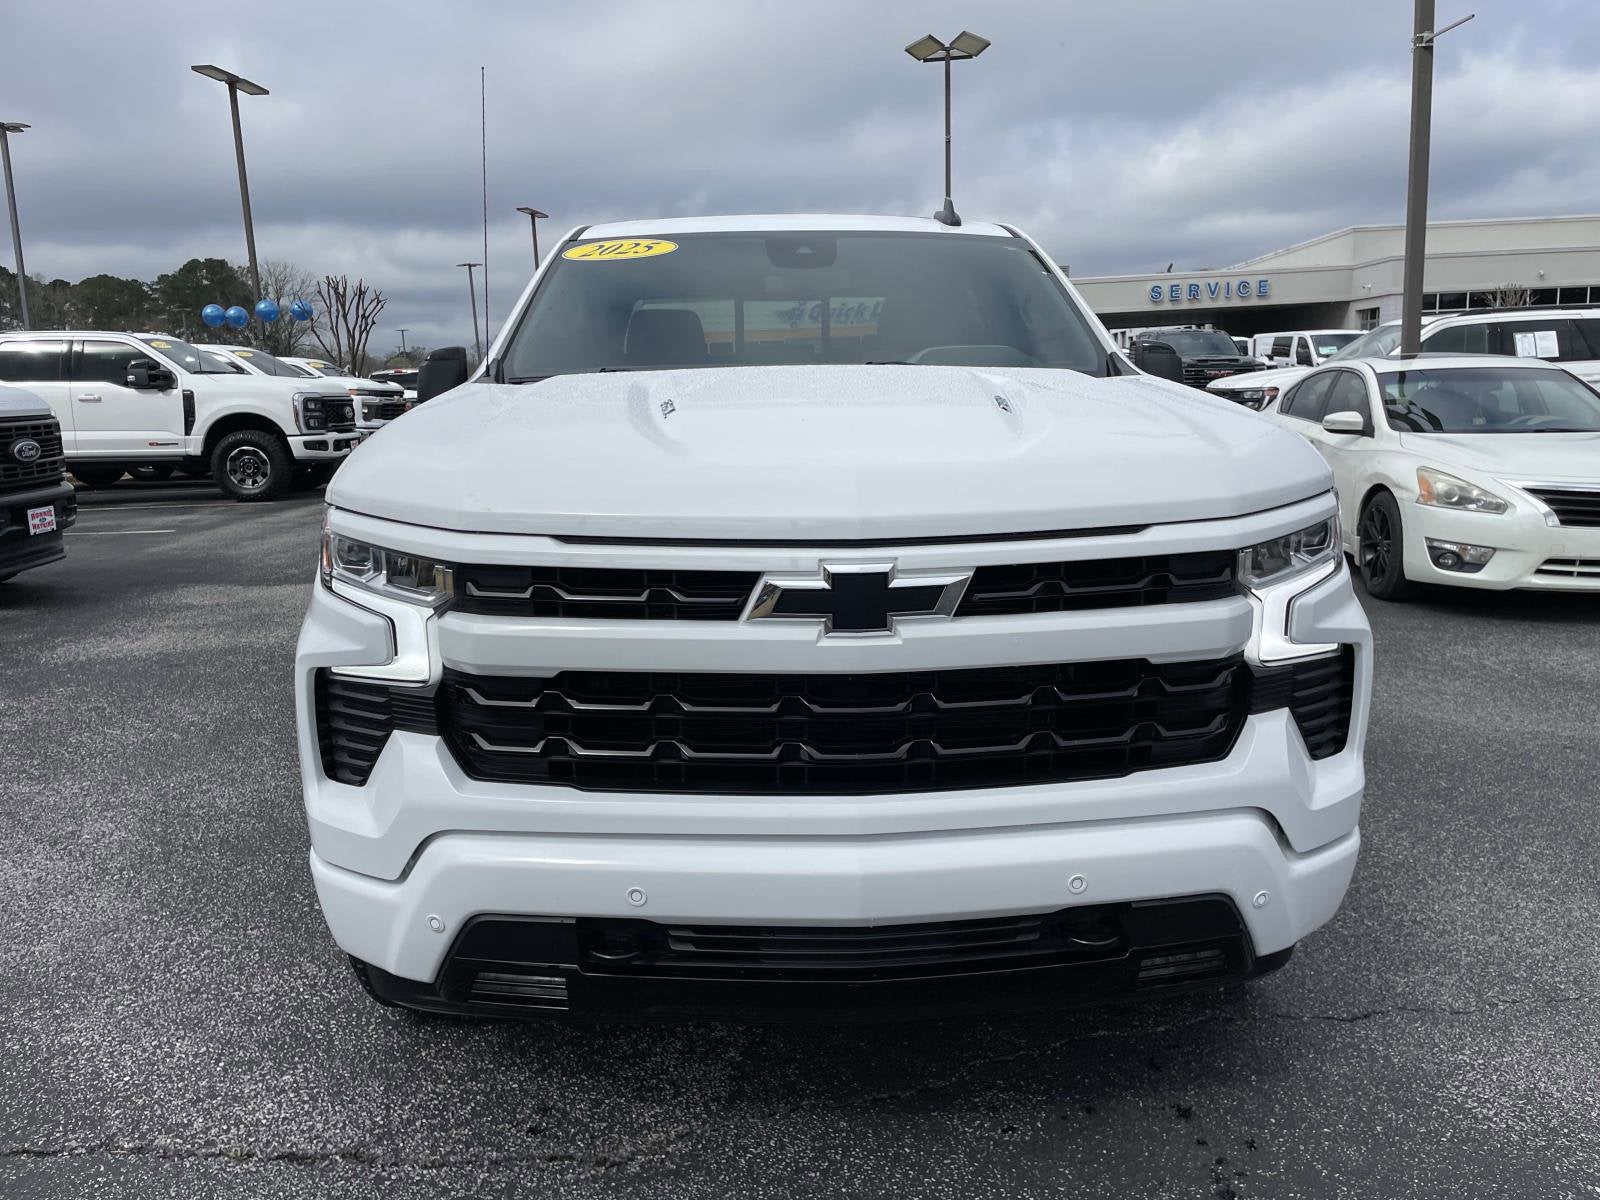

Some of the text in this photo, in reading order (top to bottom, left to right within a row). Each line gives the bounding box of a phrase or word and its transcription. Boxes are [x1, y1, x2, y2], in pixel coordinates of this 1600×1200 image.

[578, 242, 662, 258] 2025
[1150, 279, 1270, 301] SERVICE
[22, 445, 37, 457] Ford
